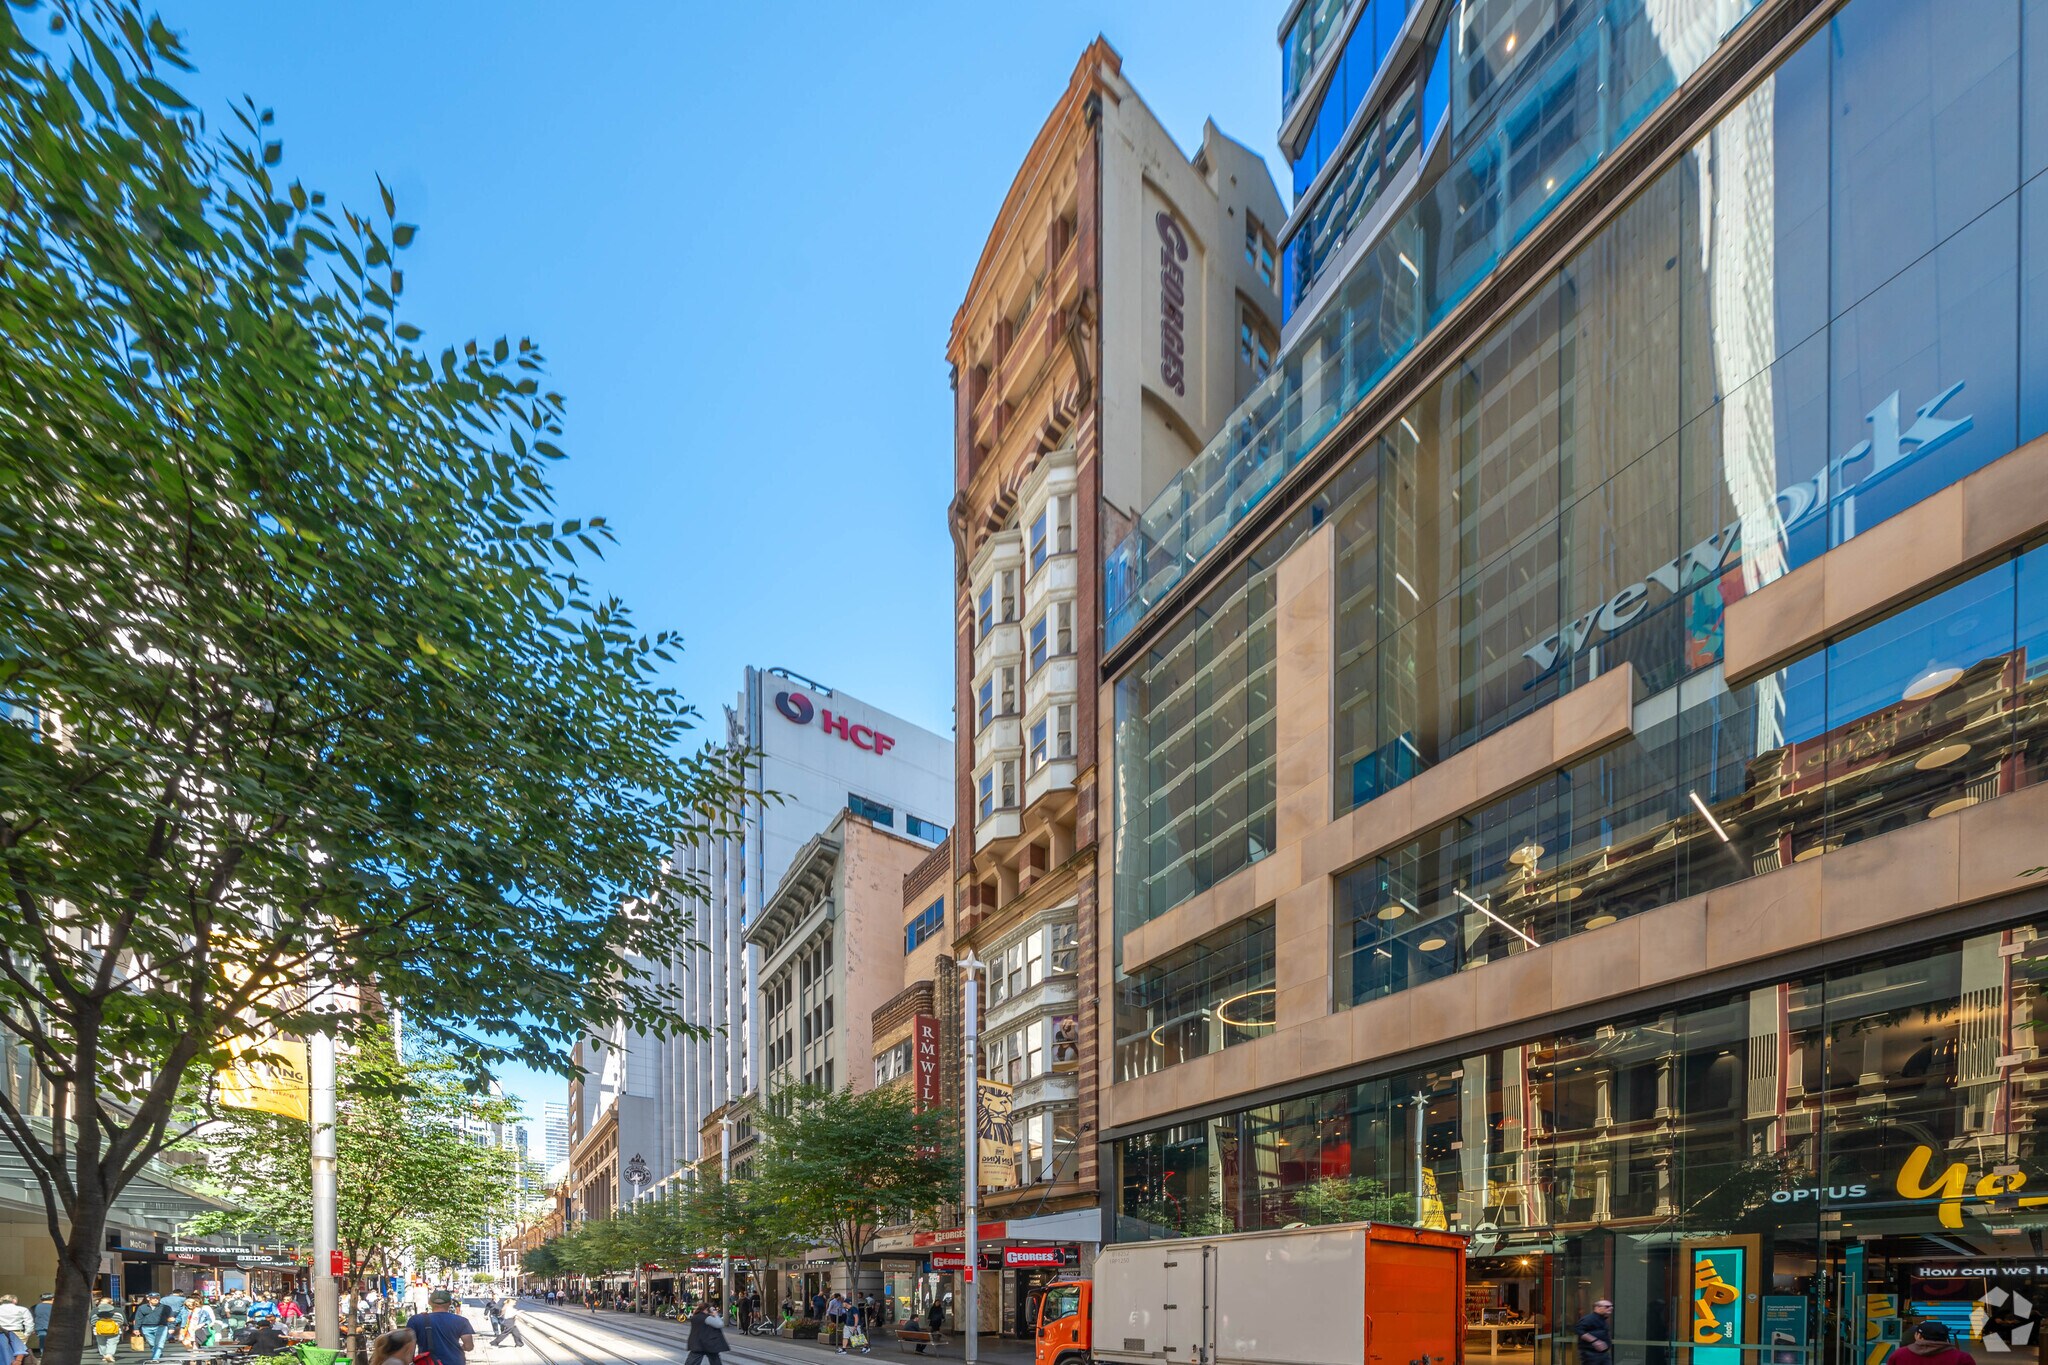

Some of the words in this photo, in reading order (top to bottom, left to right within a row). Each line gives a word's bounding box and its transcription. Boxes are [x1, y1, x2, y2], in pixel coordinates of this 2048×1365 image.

[1155, 210, 1189, 397] GEORGES
[822, 708, 895, 756] HCF
[265, 1062, 304, 1081] KING
[1771, 1184, 1867, 1203] OPTUS
[1006, 1251, 1053, 1263] GEORGES
[1919, 1267, 1957, 1277] How
[1961, 1267, 1997, 1276] can
[2001, 1266, 2031, 1275] we
[1723, 1321, 1733, 1338] deals
